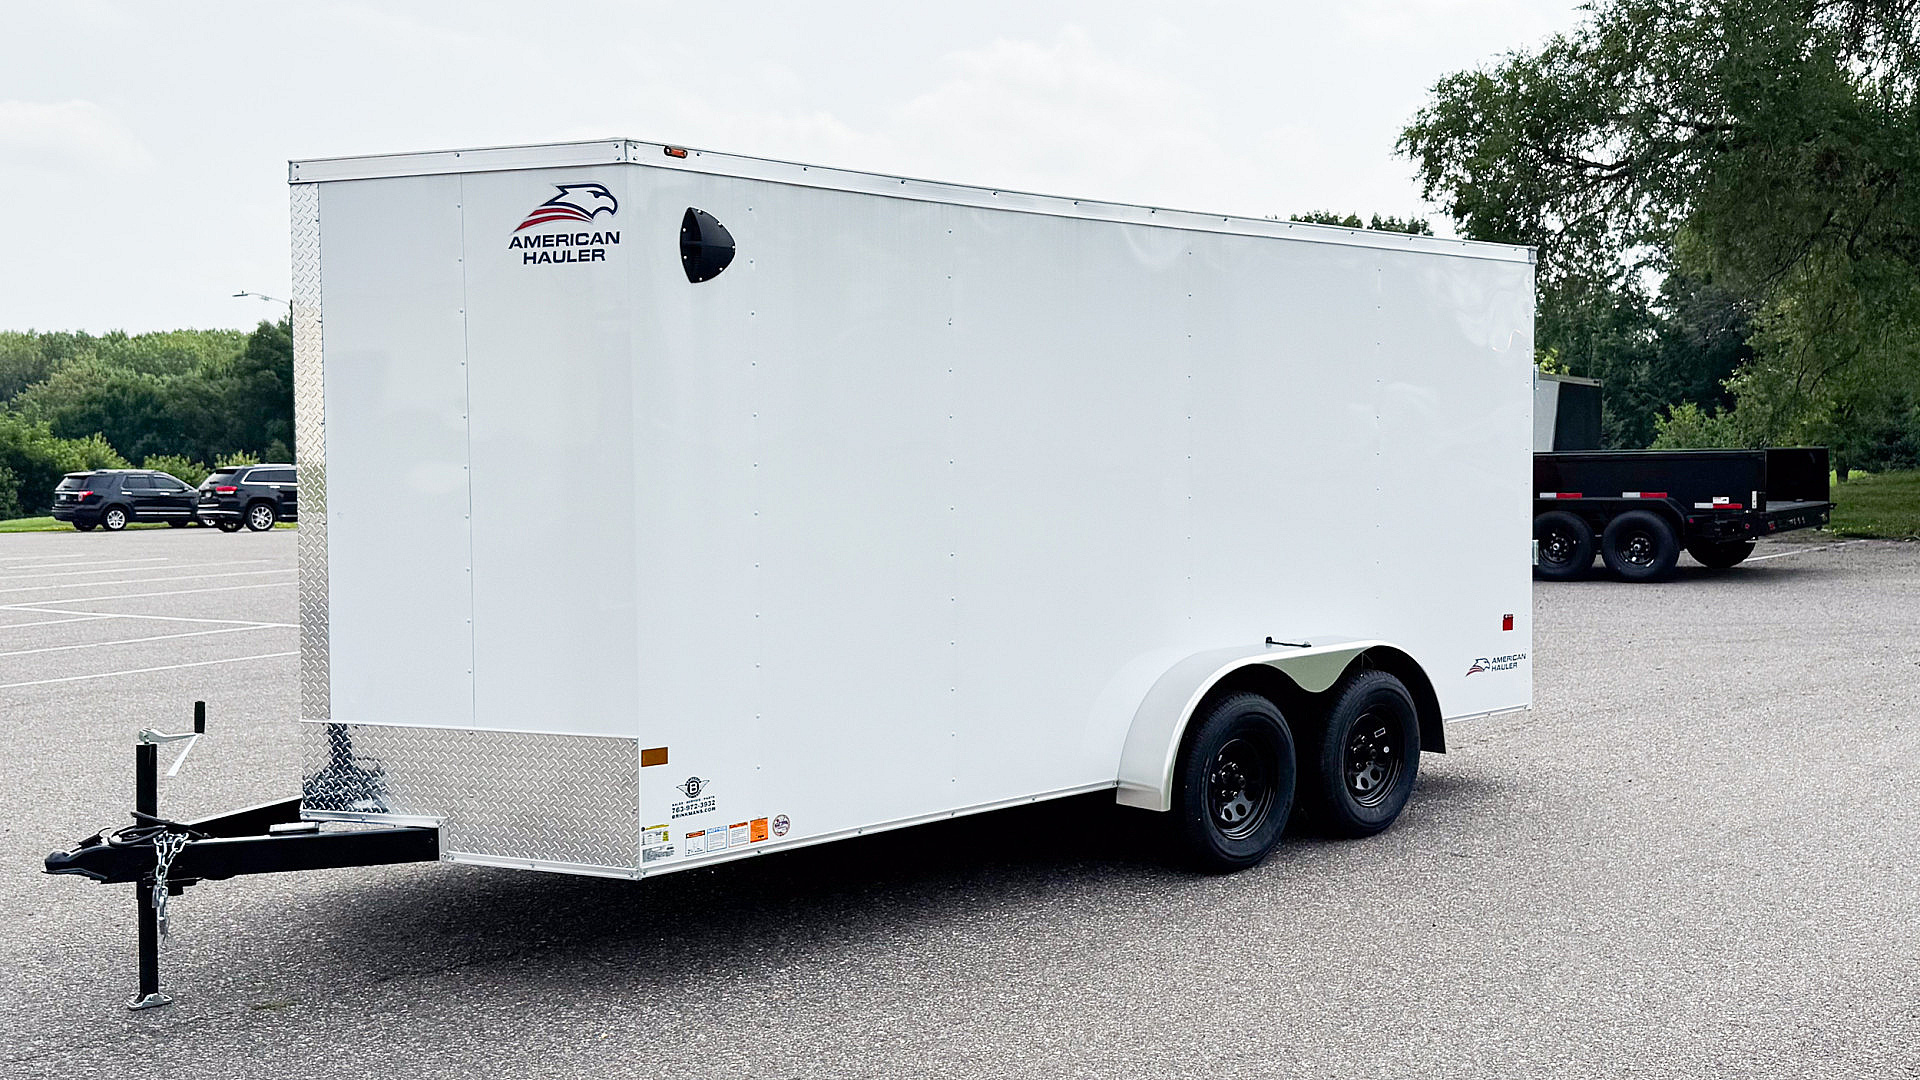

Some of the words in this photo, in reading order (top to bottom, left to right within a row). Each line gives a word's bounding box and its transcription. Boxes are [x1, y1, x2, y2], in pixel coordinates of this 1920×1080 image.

[508, 231, 620, 249] AMERICAN
[523, 248, 606, 265] HAULER
[1491, 653, 1527, 664] AMERICAN
[1491, 662, 1518, 671] HAULER
[672, 800, 715, 813] 763-972-3932
